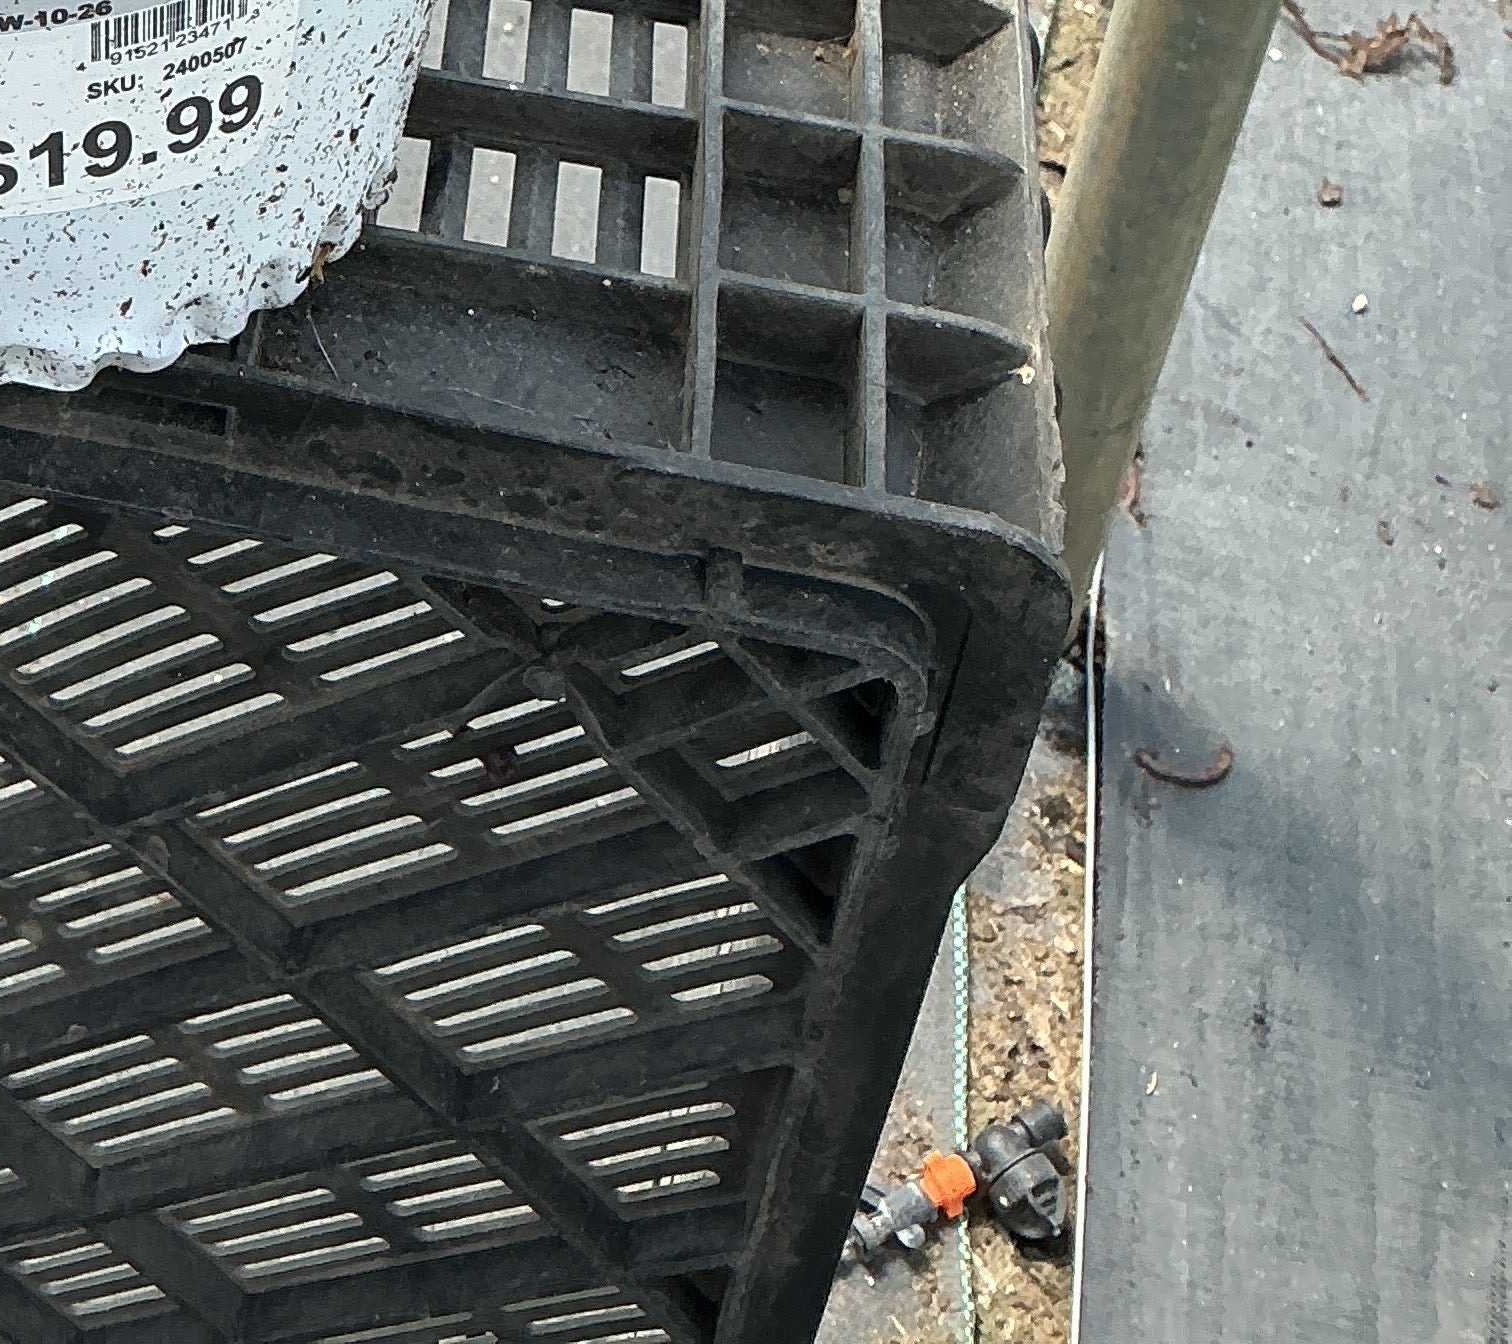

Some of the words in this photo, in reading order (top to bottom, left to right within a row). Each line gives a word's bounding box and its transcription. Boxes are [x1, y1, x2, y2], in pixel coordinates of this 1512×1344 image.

[87, 74, 143, 100] SKU:
[163, 36, 248, 81] 2400507
[110, 38, 169, 65] 91521
[176, 19, 231, 49] 23471
